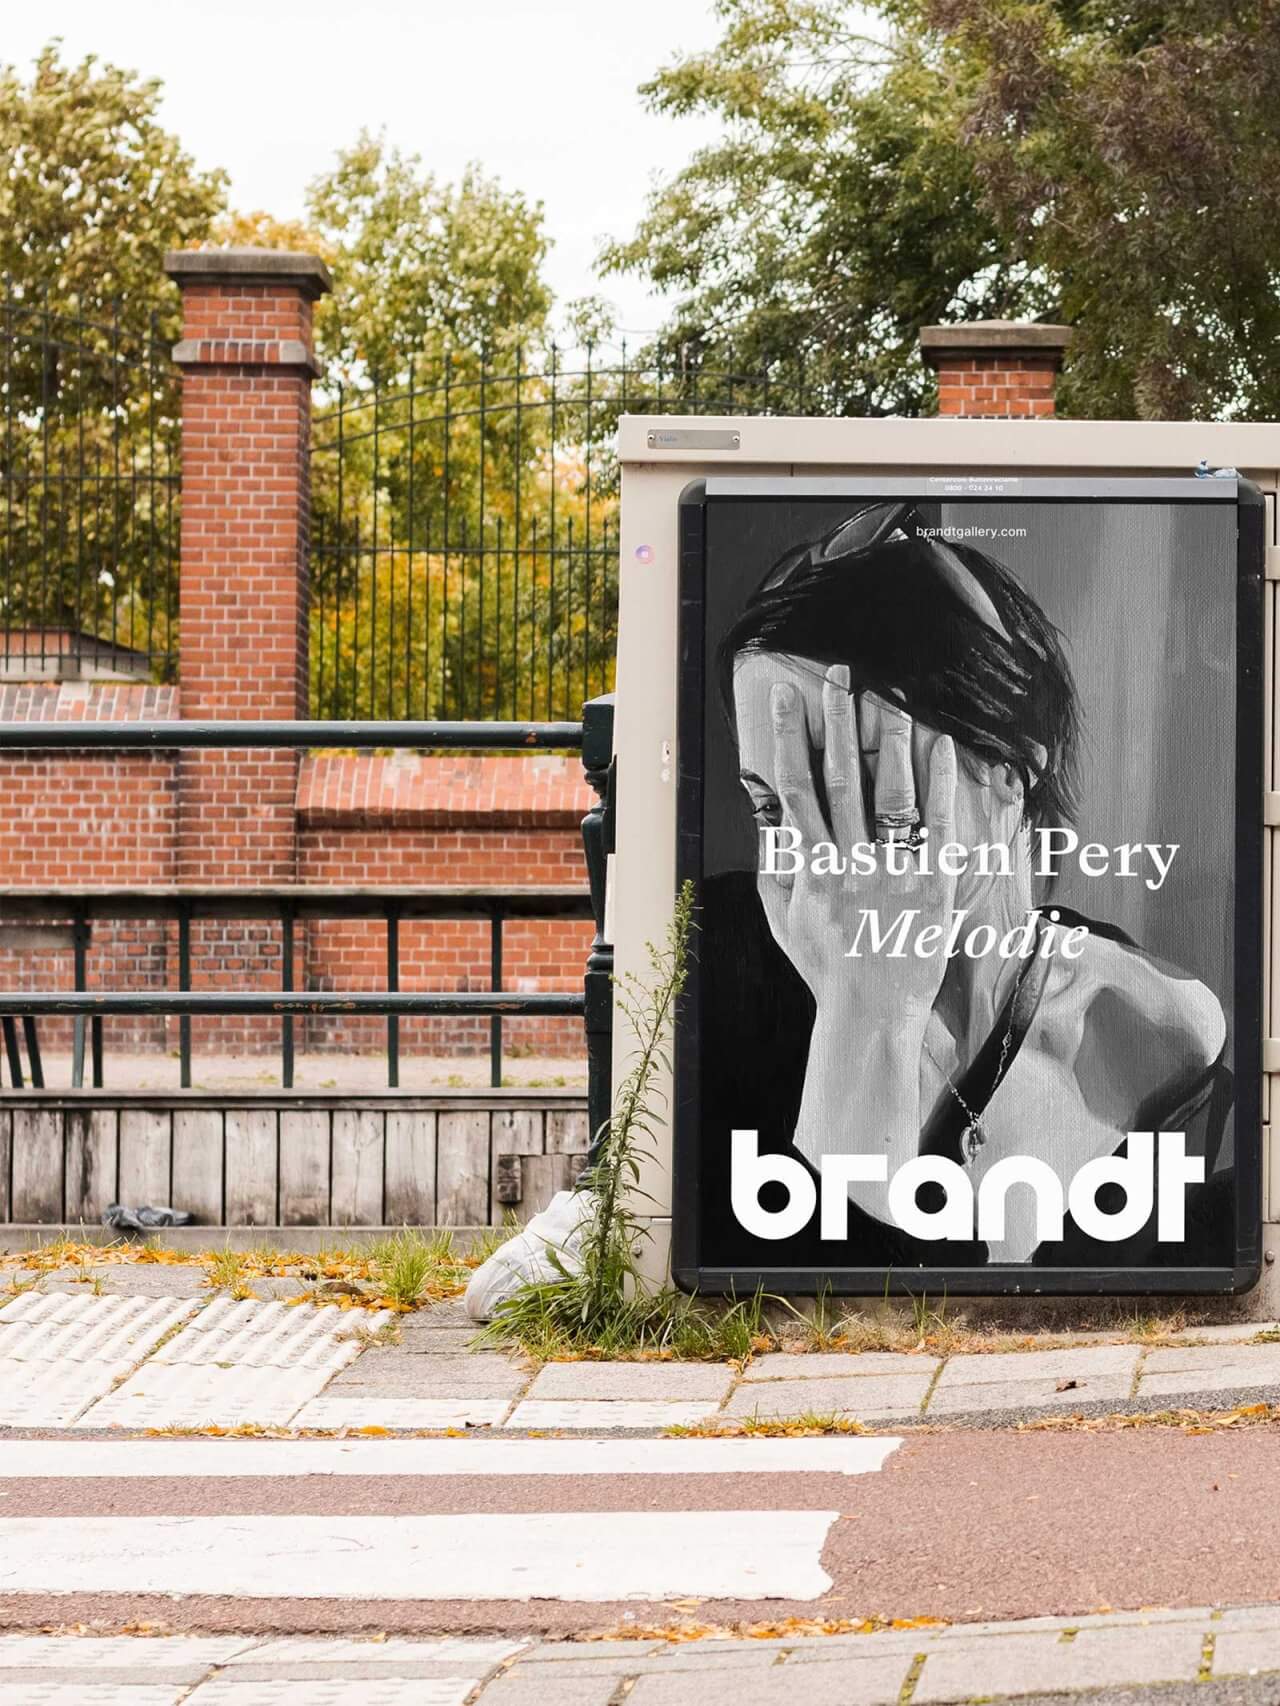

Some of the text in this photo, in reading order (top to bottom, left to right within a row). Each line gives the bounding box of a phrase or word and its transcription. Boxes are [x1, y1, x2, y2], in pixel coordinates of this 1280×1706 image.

[916, 526, 1027, 539] brandtgallery.com
[759, 826, 1181, 890] Bastien Pery
[845, 909, 1090, 960] Melodie
[730, 1129, 1206, 1243] brandt
